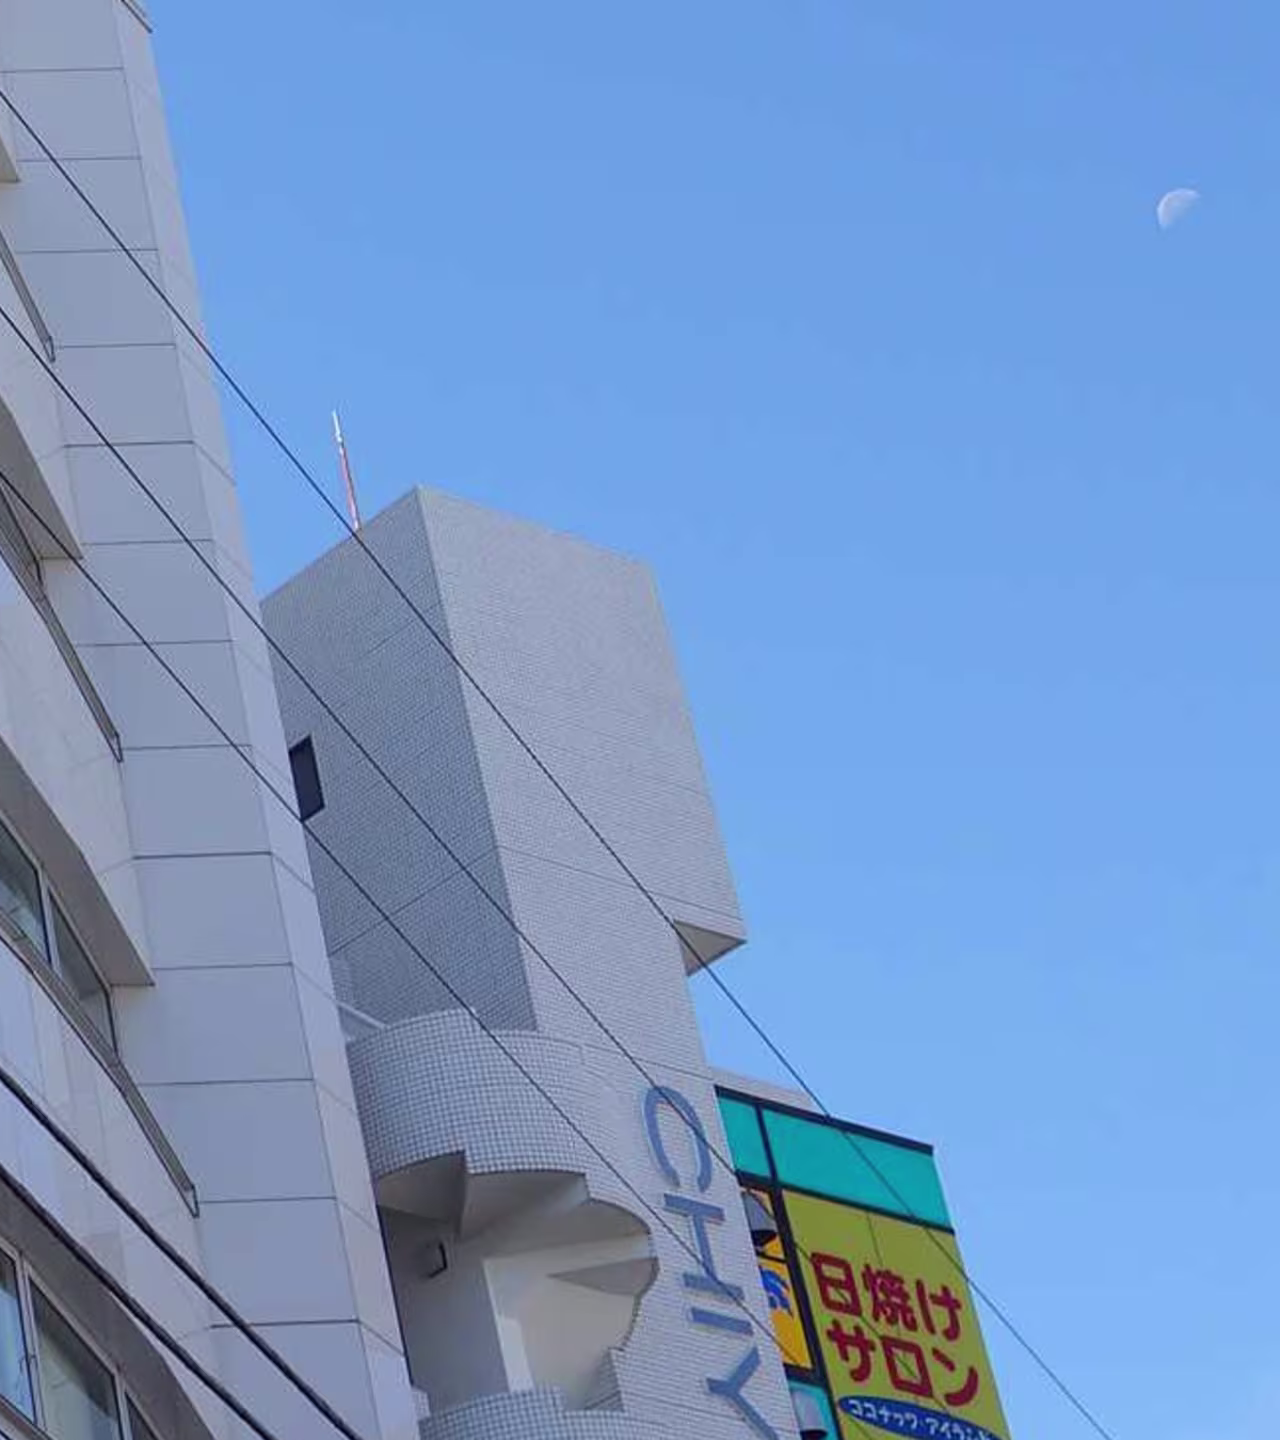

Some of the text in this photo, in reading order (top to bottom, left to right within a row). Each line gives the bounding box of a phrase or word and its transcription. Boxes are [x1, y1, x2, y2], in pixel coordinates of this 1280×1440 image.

[810, 1251, 963, 1342] 日焼け
[826, 1318, 980, 1407] サロン
